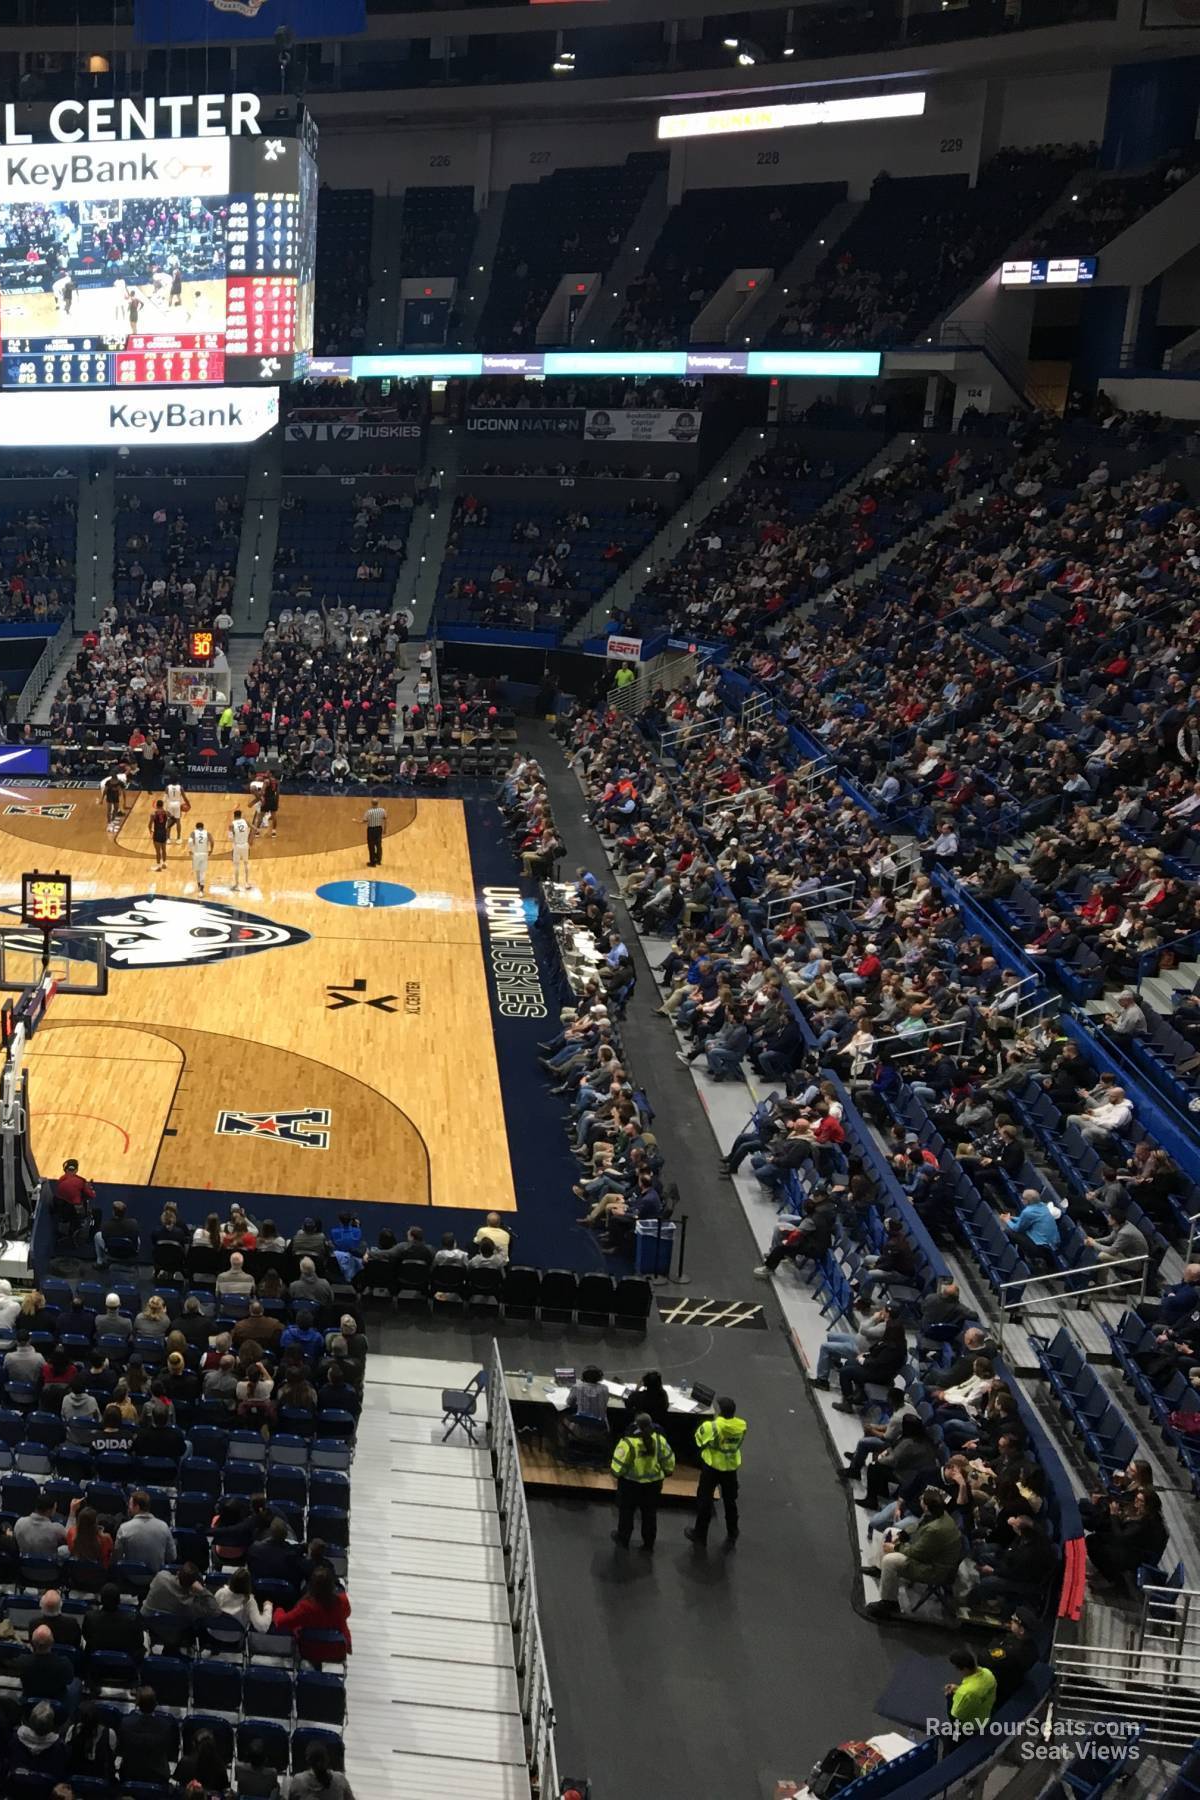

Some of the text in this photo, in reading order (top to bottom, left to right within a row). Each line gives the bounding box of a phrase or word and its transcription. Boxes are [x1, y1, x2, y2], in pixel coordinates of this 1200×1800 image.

[49, 92, 262, 144] CENTER
[940, 138, 963, 153] 229
[430, 155, 451, 167] 226
[757, 151, 780, 165] 228
[7, 151, 159, 191] KeyBank
[109, 403, 243, 433] KeyBank
[467, 419, 519, 431] UCONN
[359, 426, 421, 439] HUSKIES
[172, 478, 188, 486] 121
[340, 477, 356, 485] 122
[559, 479, 575, 487] 123
[194, 632, 212, 641] 12:50
[193, 641, 210, 656] 30
[608, 641, 640, 656] ESPN
[187, 764, 228, 774] TRAVELERS
[237, 823, 246, 833] 12
[482, 886, 548, 1018] UCONN HUSKIES
[405, 980, 421, 1015] XL CENTER
